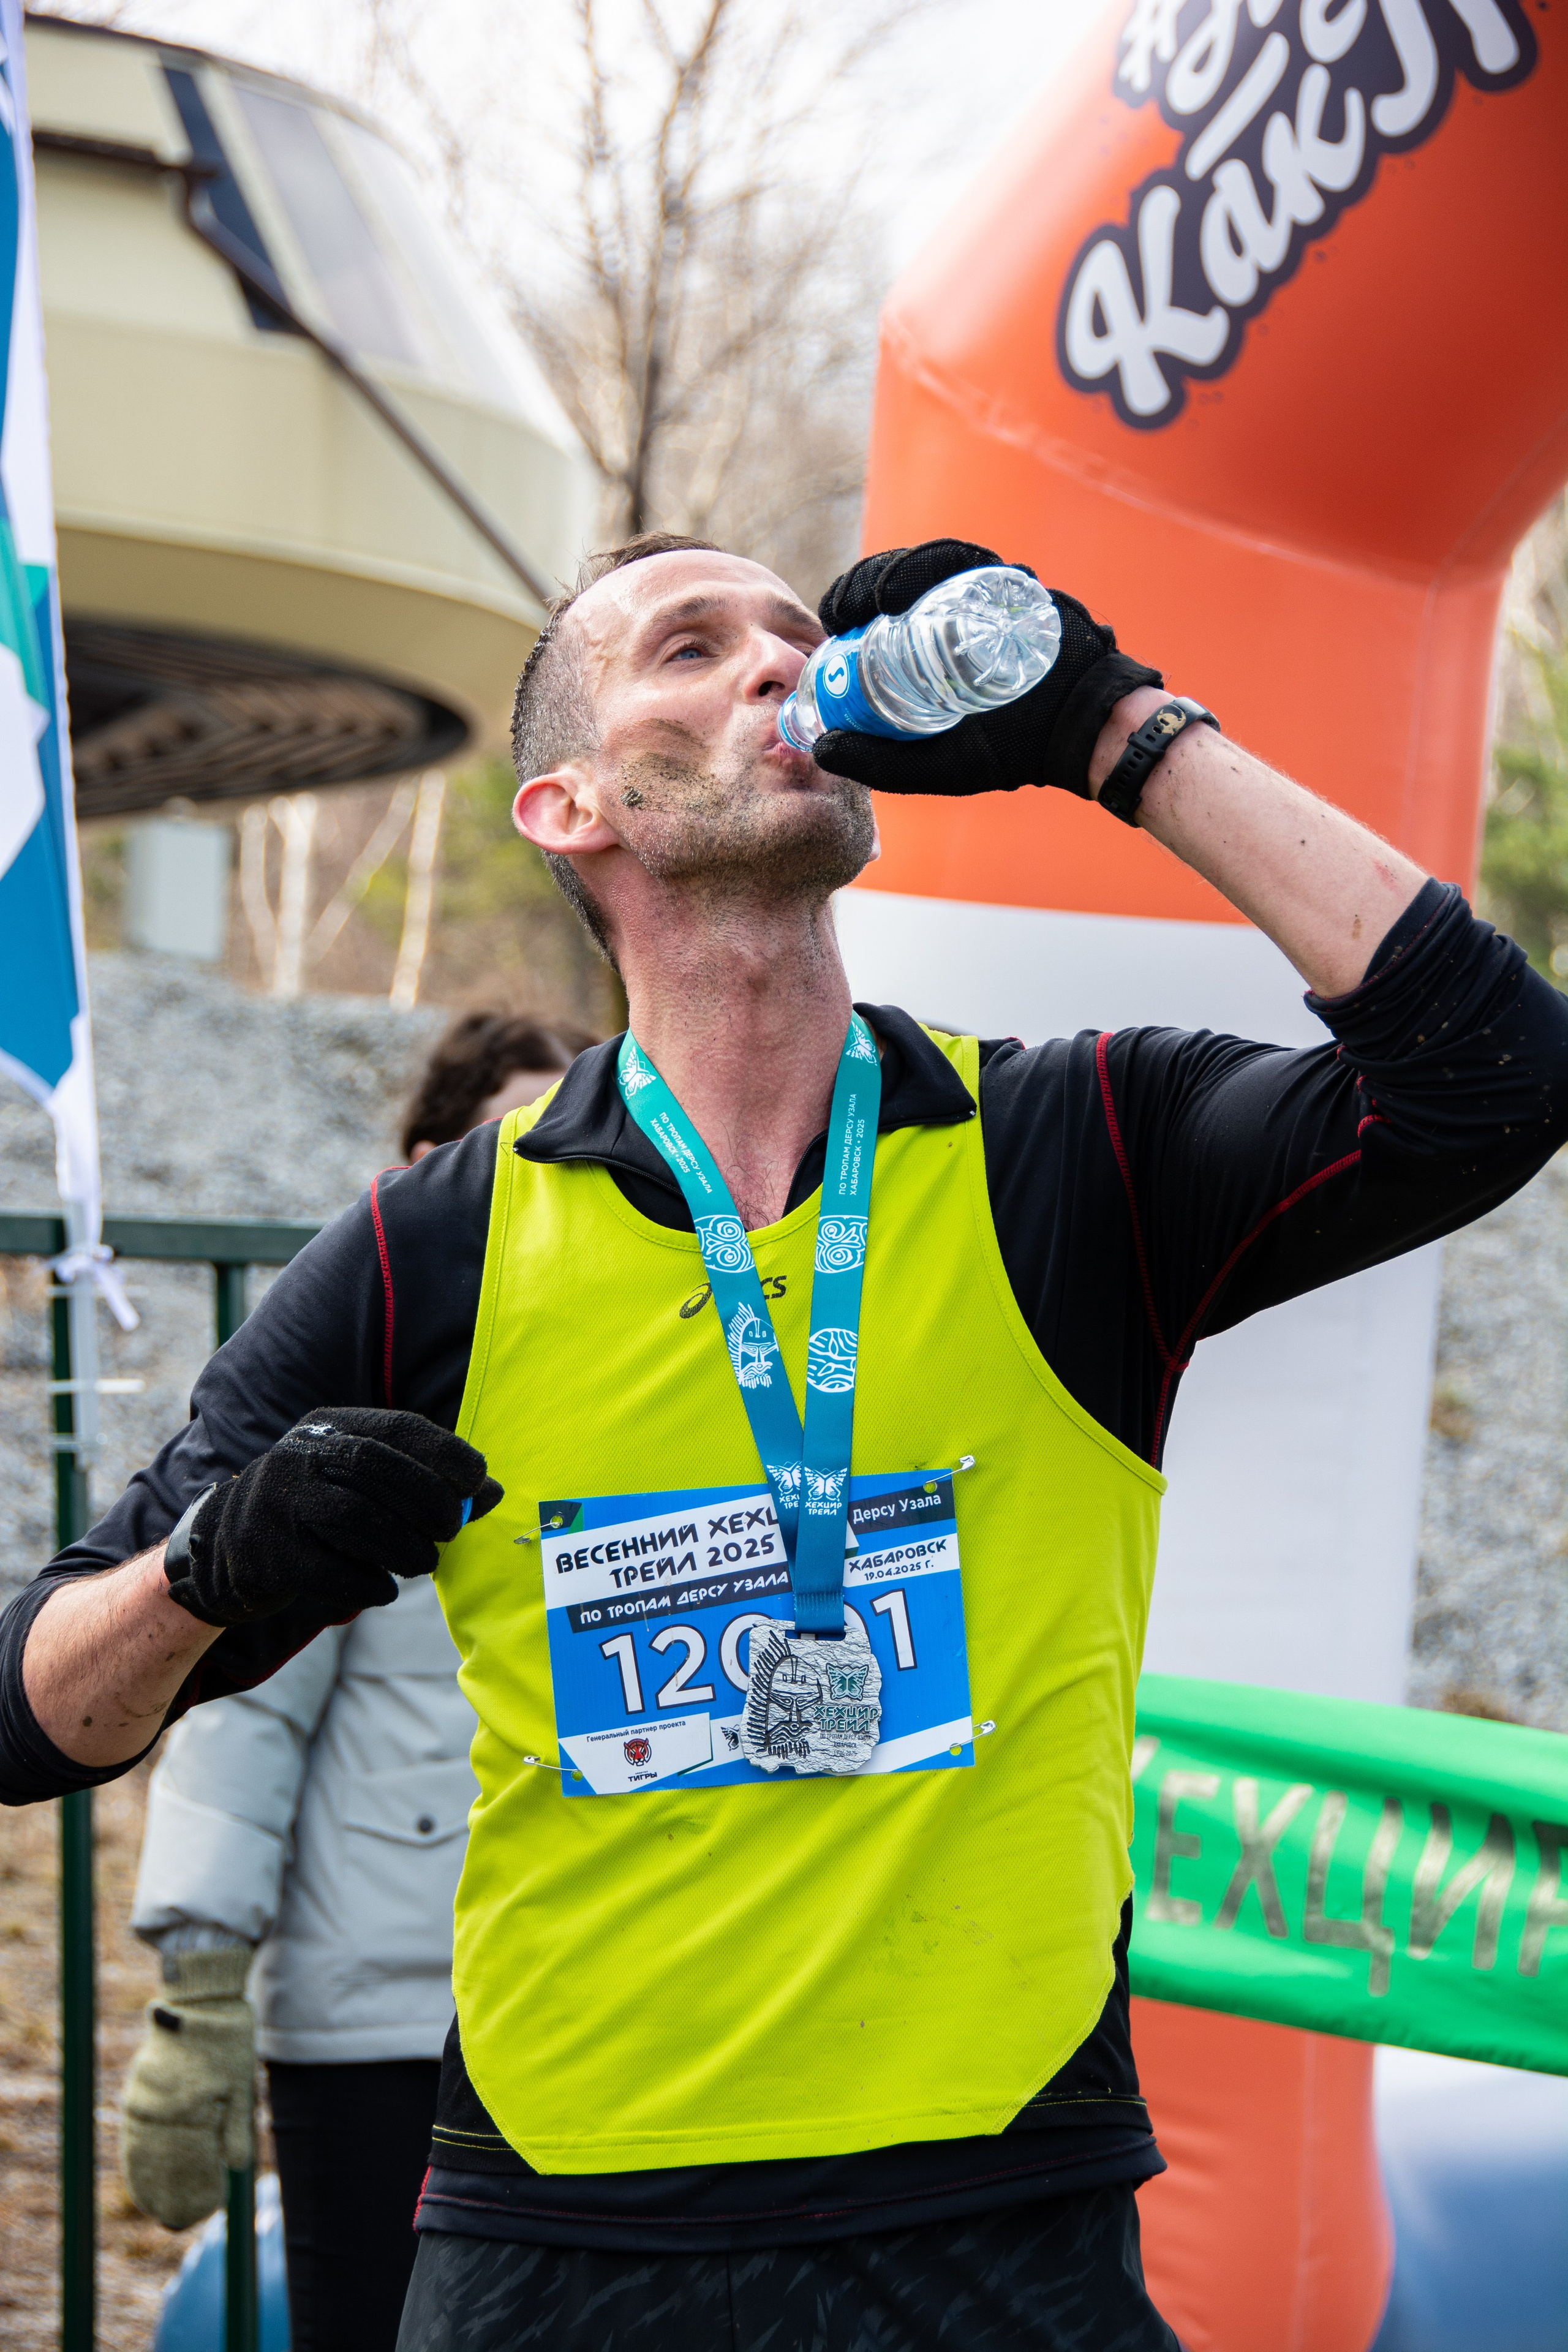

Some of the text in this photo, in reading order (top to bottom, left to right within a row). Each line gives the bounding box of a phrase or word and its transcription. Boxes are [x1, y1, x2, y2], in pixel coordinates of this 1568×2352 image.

[650, 1118, 691, 1173] ХАБАРОВСК 2025
[659, 1112, 713, 1194] ПО ТРОПАМ ДЕРСУ УЗАЛА
[839, 1094, 857, 1195] ПО ТРОПАМ ДЕРСУ УЗАЛА
[850, 1119, 865, 1195] ХАБАРОВСК 2025
[784, 1501, 799, 1509] ТРЕ
[853, 1494, 941, 1525] Дерсу Узала
[555, 1523, 699, 1575] ВЕСЕННИЙ
[609, 1532, 775, 1588] ТРЕЙЛ 2025
[849, 1539, 947, 1574] ХАБАРОВСК
[864, 1561, 921, 1581] 19.04.2025
[579, 1571, 789, 1625] ПО ТРОПАМ ДЕРСУ УЗАЛА
[813, 1705, 879, 1719] ХЕХЦИР
[819, 1717, 870, 1732] ТРЕЙЛ
[587, 1720, 686, 1743] Генеральный партнер проекта
[628, 1772, 658, 1782] ТИГРЫ
